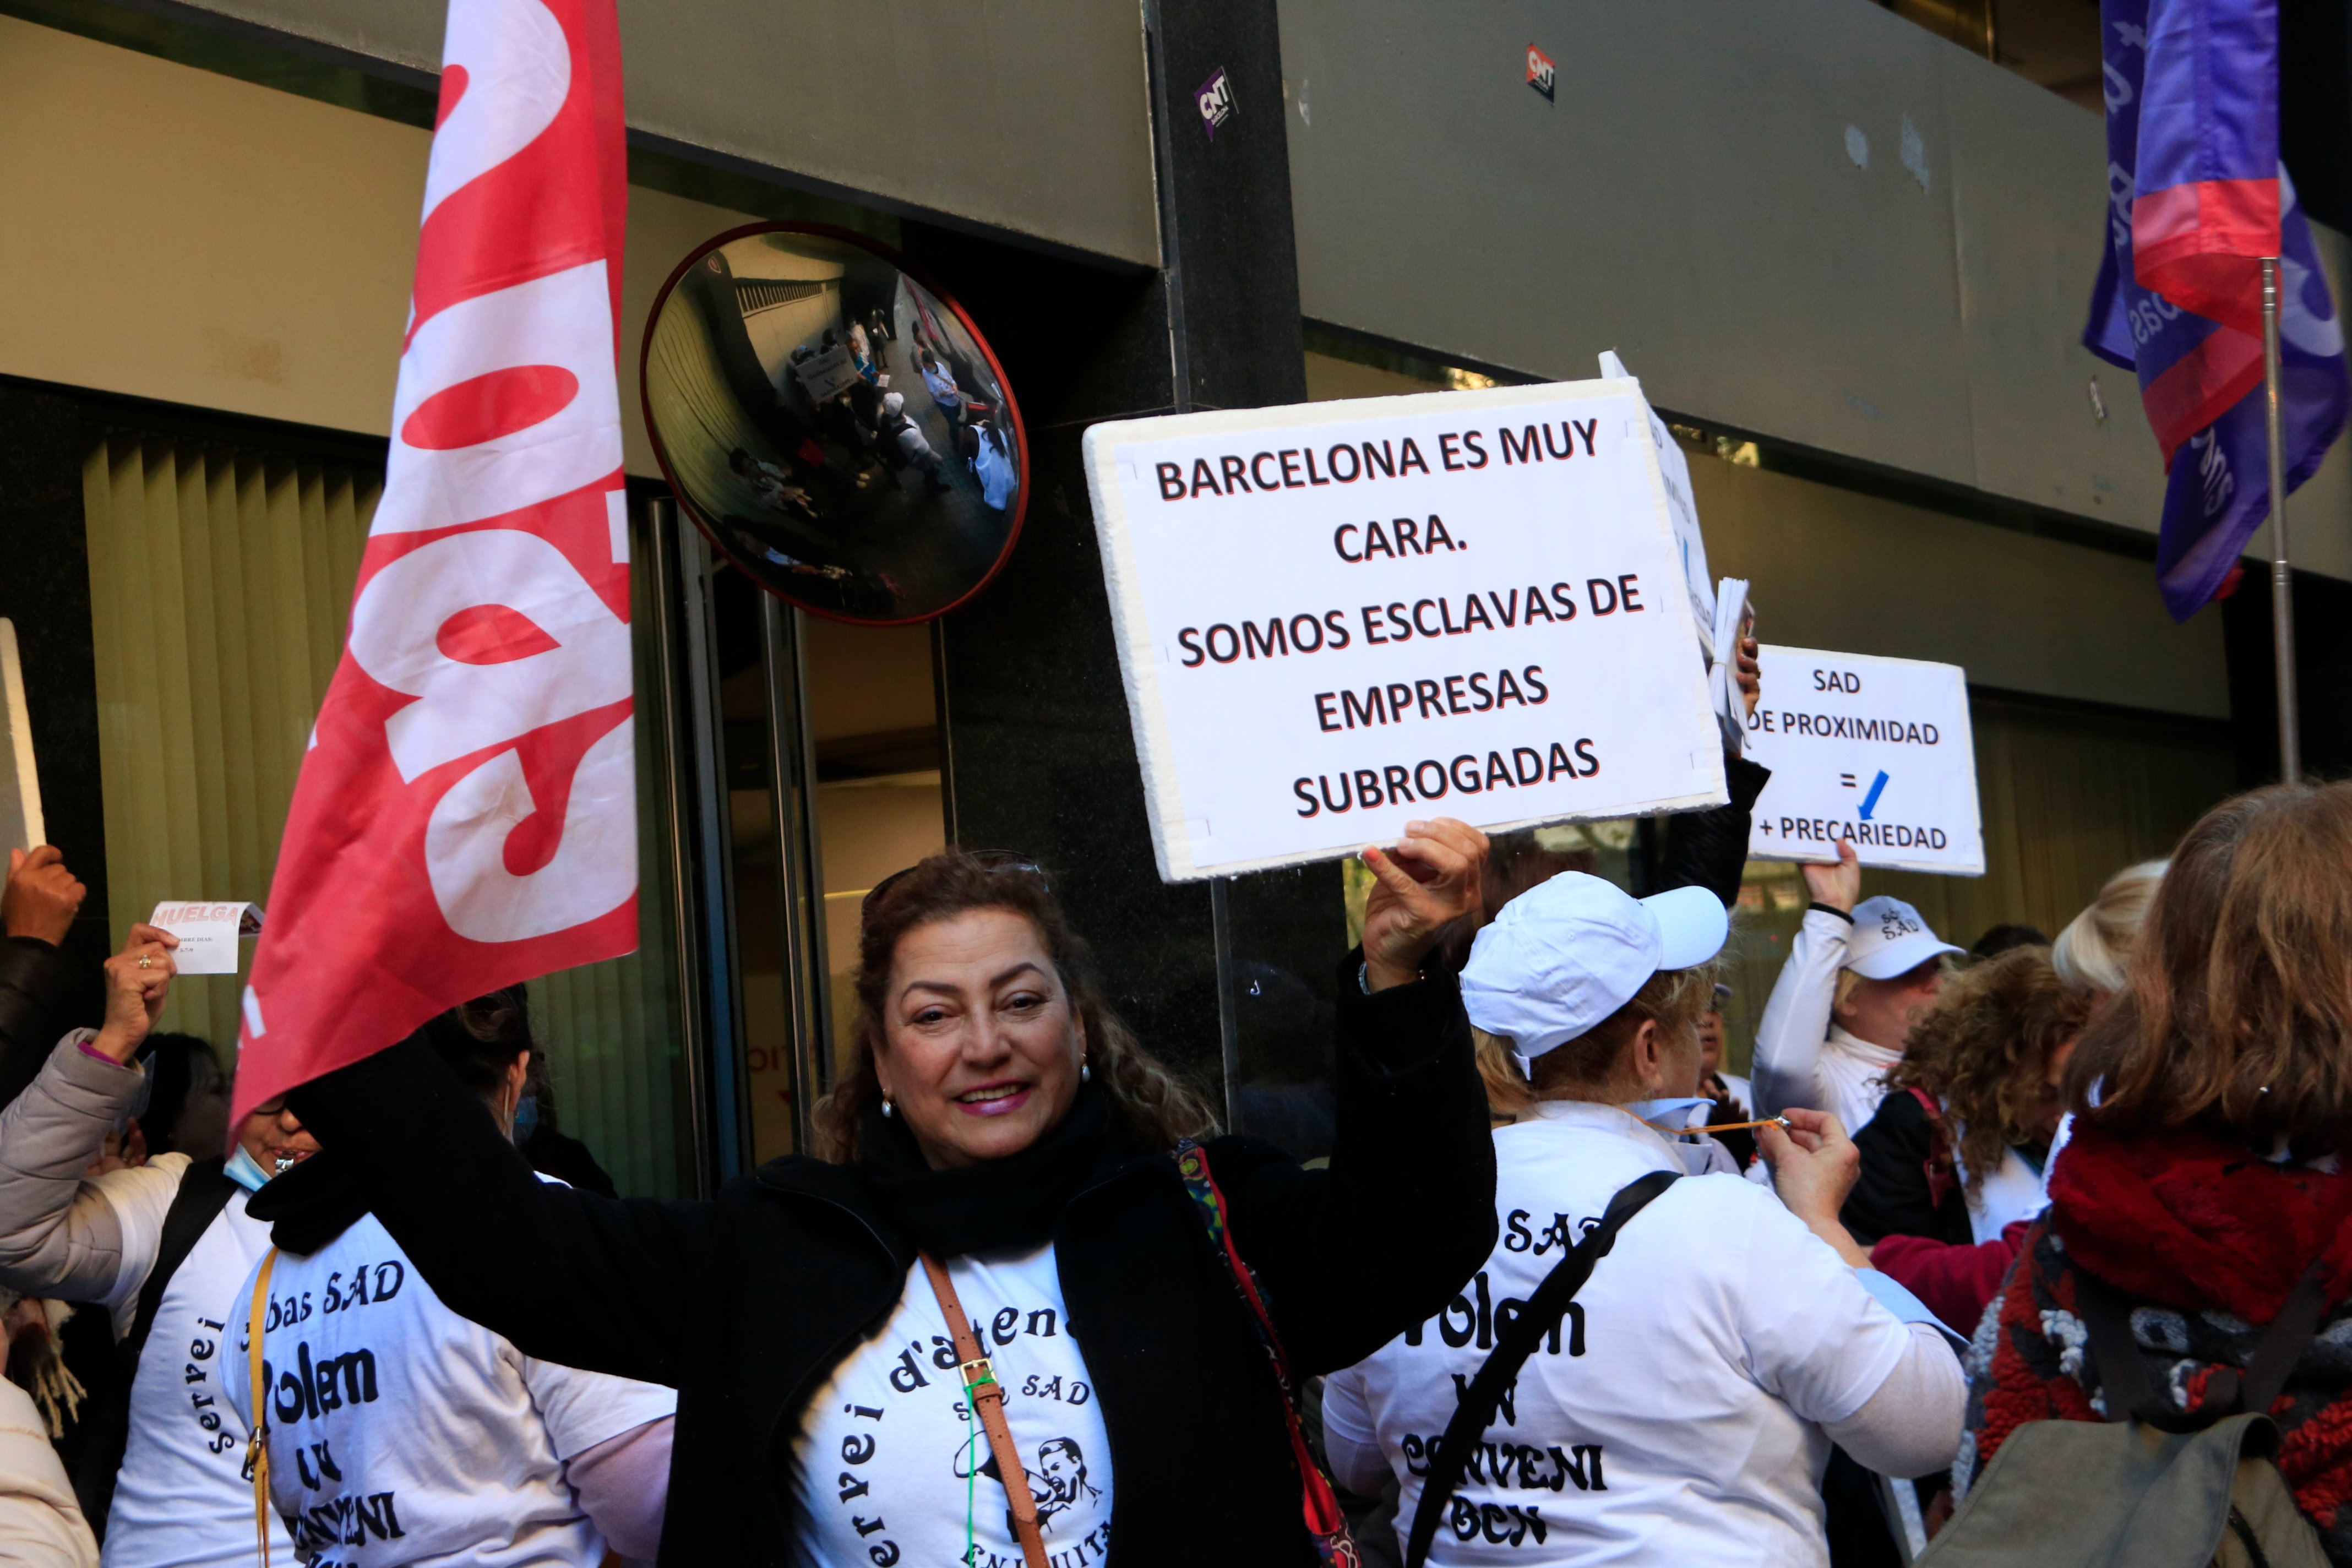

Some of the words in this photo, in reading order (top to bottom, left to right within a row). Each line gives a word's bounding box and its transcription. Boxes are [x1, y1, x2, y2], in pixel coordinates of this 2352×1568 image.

[1528, 51, 1554, 86] CNT
[1200, 75, 1228, 119] CNT
[1156, 437, 1430, 502] BARCELONA
[1439, 430, 1489, 472] ES
[1499, 418, 1598, 466] MUY
[1333, 514, 1467, 564] CARA.
[1178, 609, 1351, 667] SOMOS
[1362, 582, 1577, 646] ESCLAVAS
[1587, 574, 1644, 614] DE
[1314, 665, 1549, 733] EMPRESAS
[1814, 669, 1860, 694] SAD
[1783, 712, 1939, 745] PROXIMIDAD
[1293, 738, 1600, 818] SUBROGADAS
[1781, 817, 1946, 850] PRECARIEDAD
[1881, 916, 1919, 939] SAD
[323, 1260, 404, 1314] SAD
[889, 1306, 1075, 1393] d'aten
[186, 1316, 235, 1454] servei
[1022, 1375, 1089, 1406] SAD
[1450, 1495, 1548, 1547] BCN
